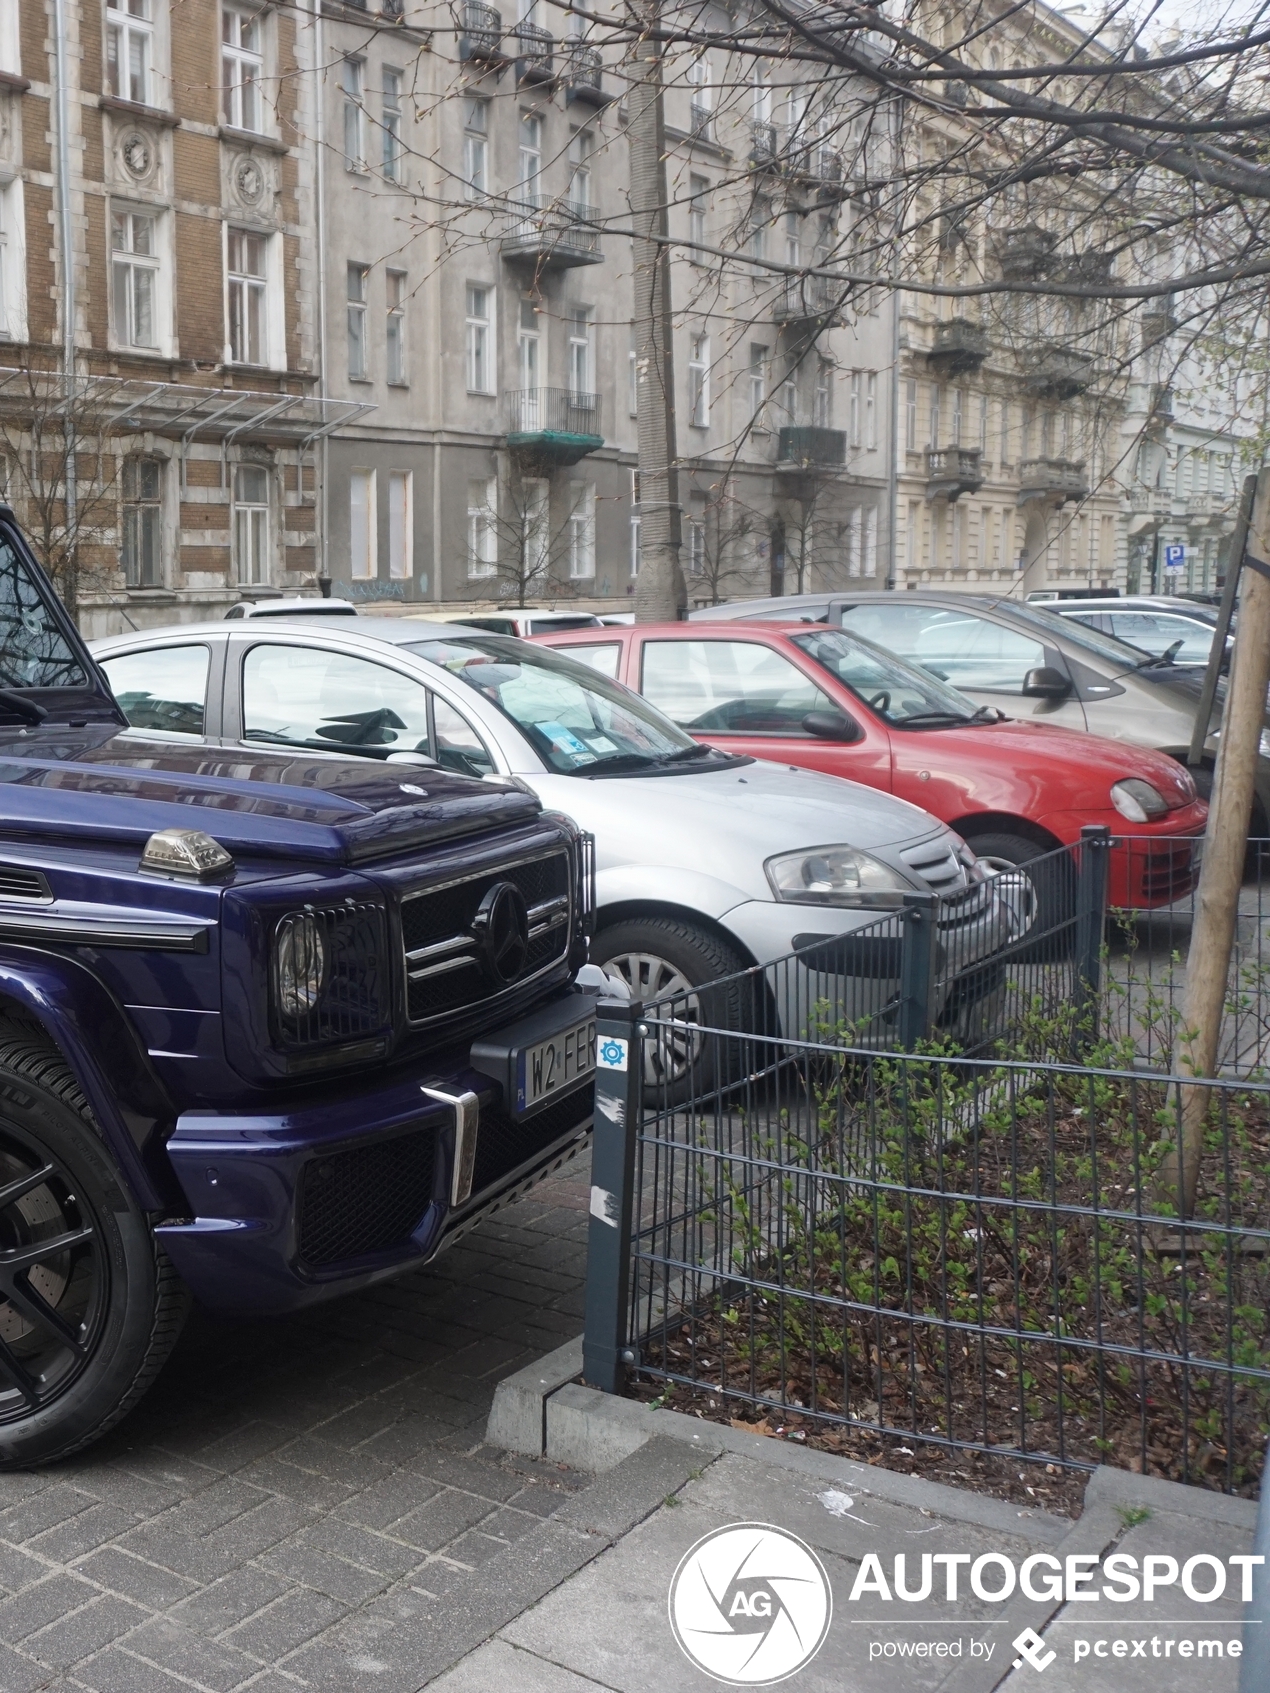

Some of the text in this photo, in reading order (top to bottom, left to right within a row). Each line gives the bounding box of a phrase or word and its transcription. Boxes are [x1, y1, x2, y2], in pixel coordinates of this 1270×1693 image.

[1170, 547, 1181, 560] P
[532, 1043, 556, 1098] W2
[517, 1087, 525, 1102] PL
[42, 1110, 68, 1133] PILOT
